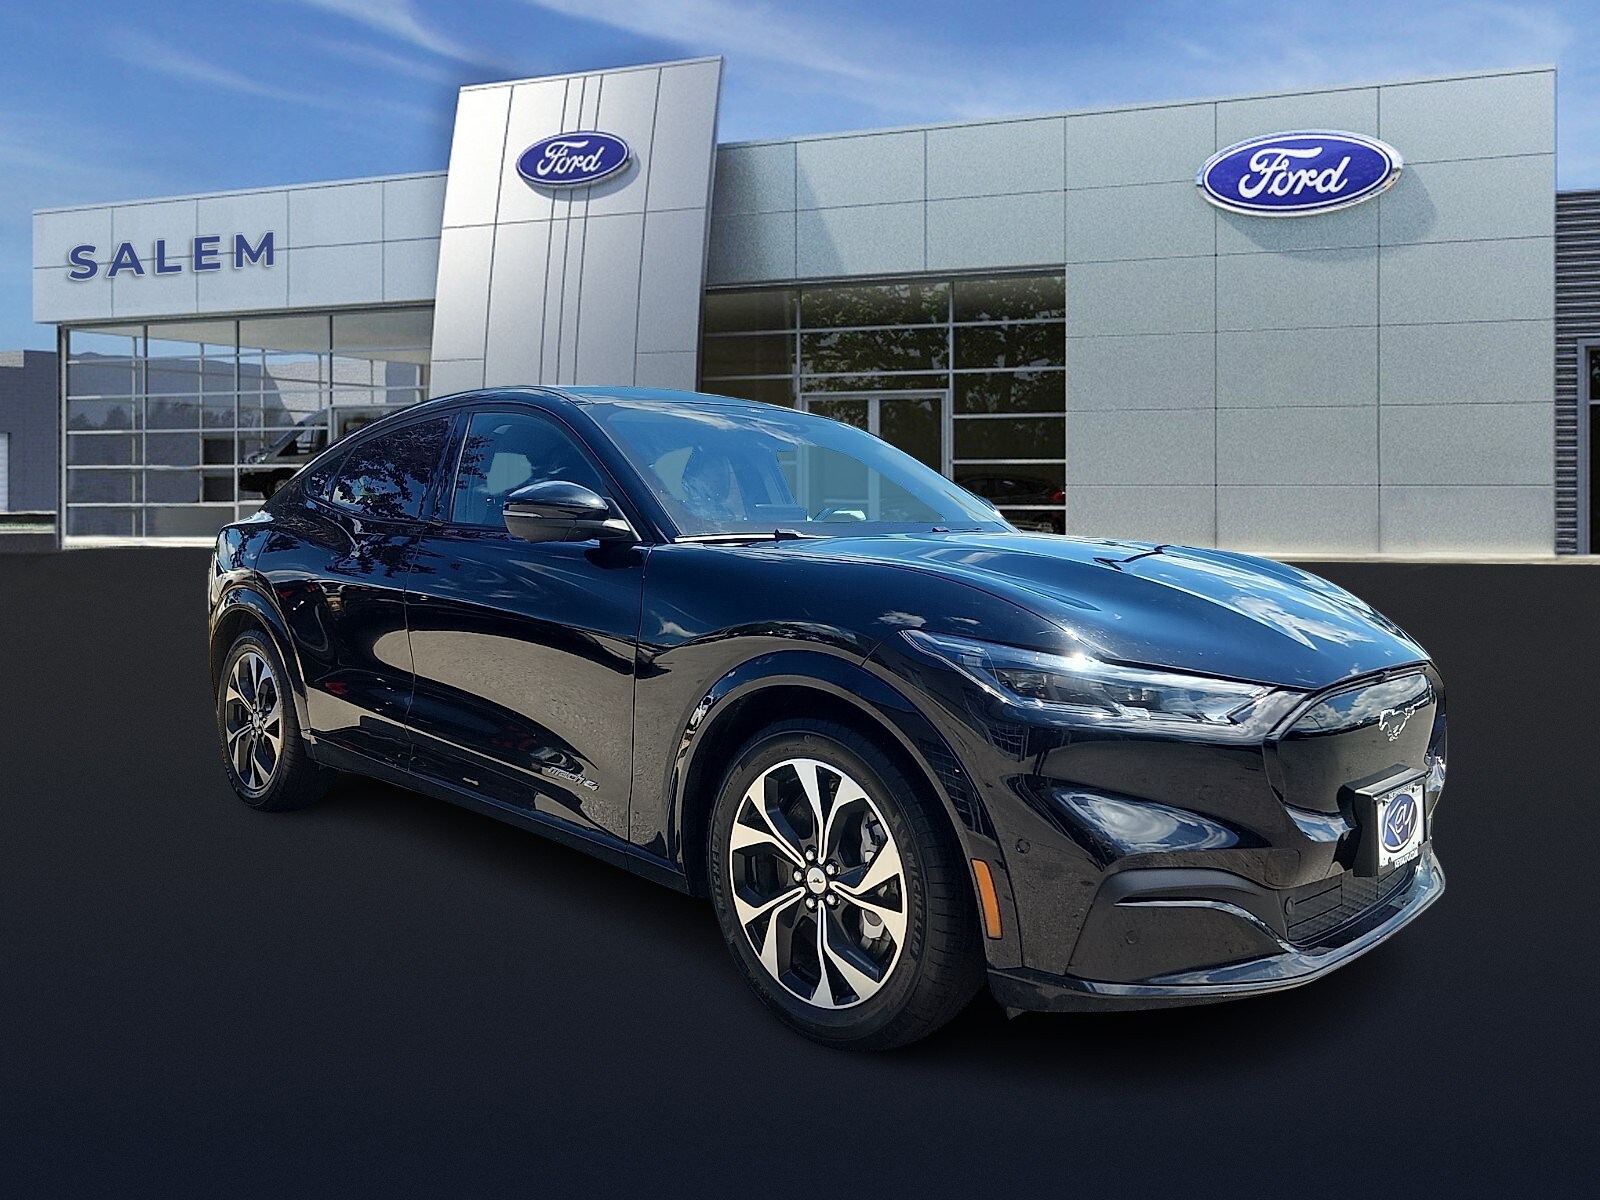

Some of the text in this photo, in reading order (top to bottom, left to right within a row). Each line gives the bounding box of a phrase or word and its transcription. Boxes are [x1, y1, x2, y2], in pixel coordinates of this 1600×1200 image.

[536, 140, 605, 176] Ford
[1238, 146, 1351, 199] Ford
[67, 231, 275, 281] SALEM
[1382, 799, 1415, 846] Key
[906, 851, 923, 957] MICHELIN
